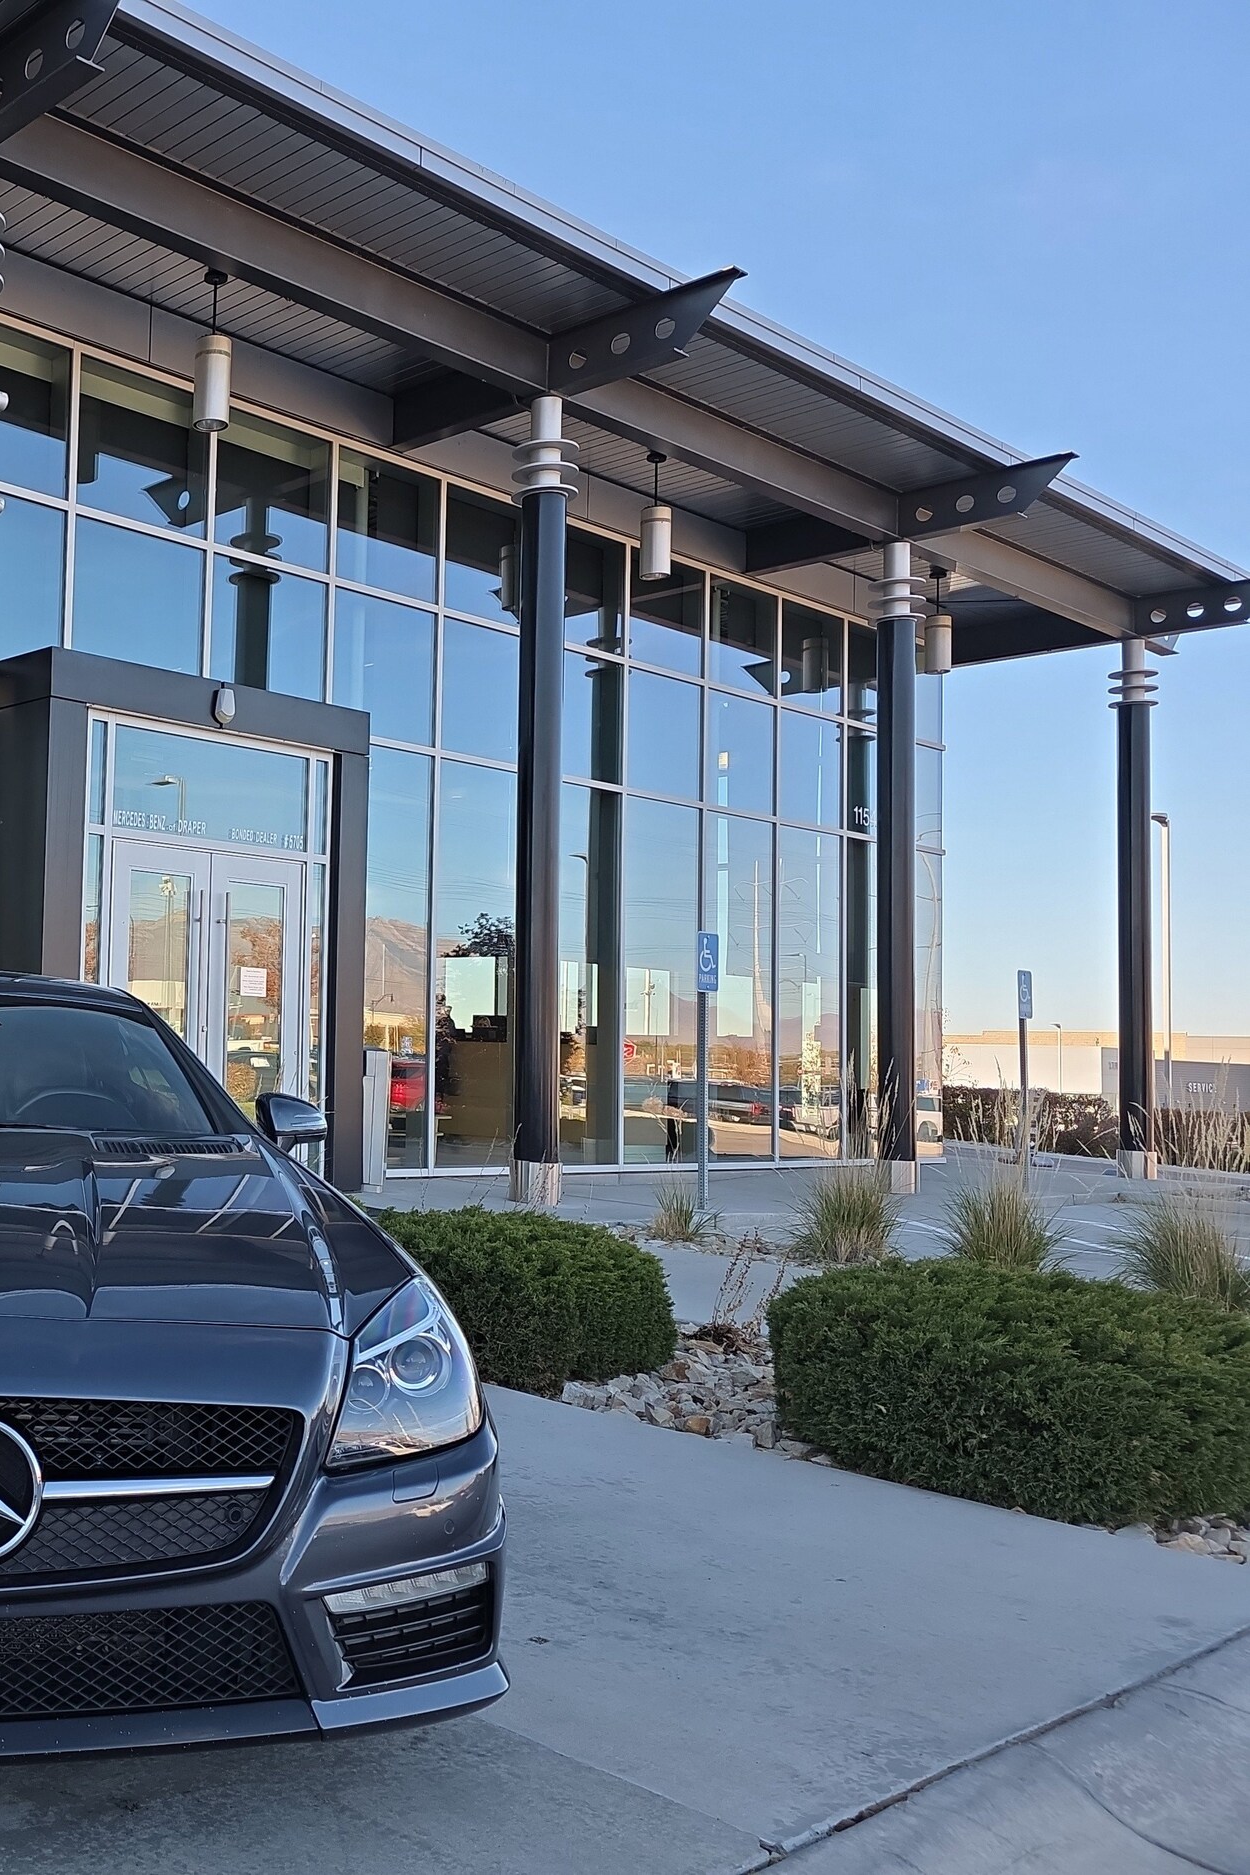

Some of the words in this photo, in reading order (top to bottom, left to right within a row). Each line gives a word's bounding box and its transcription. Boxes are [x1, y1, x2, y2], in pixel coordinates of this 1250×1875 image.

[149, 814, 166, 831] BENZ
[177, 820, 207, 835] DRAPER
[231, 828, 253, 842] BONDED
[255, 831, 278, 845] DEALER
[698, 973, 717, 985] PARKING
